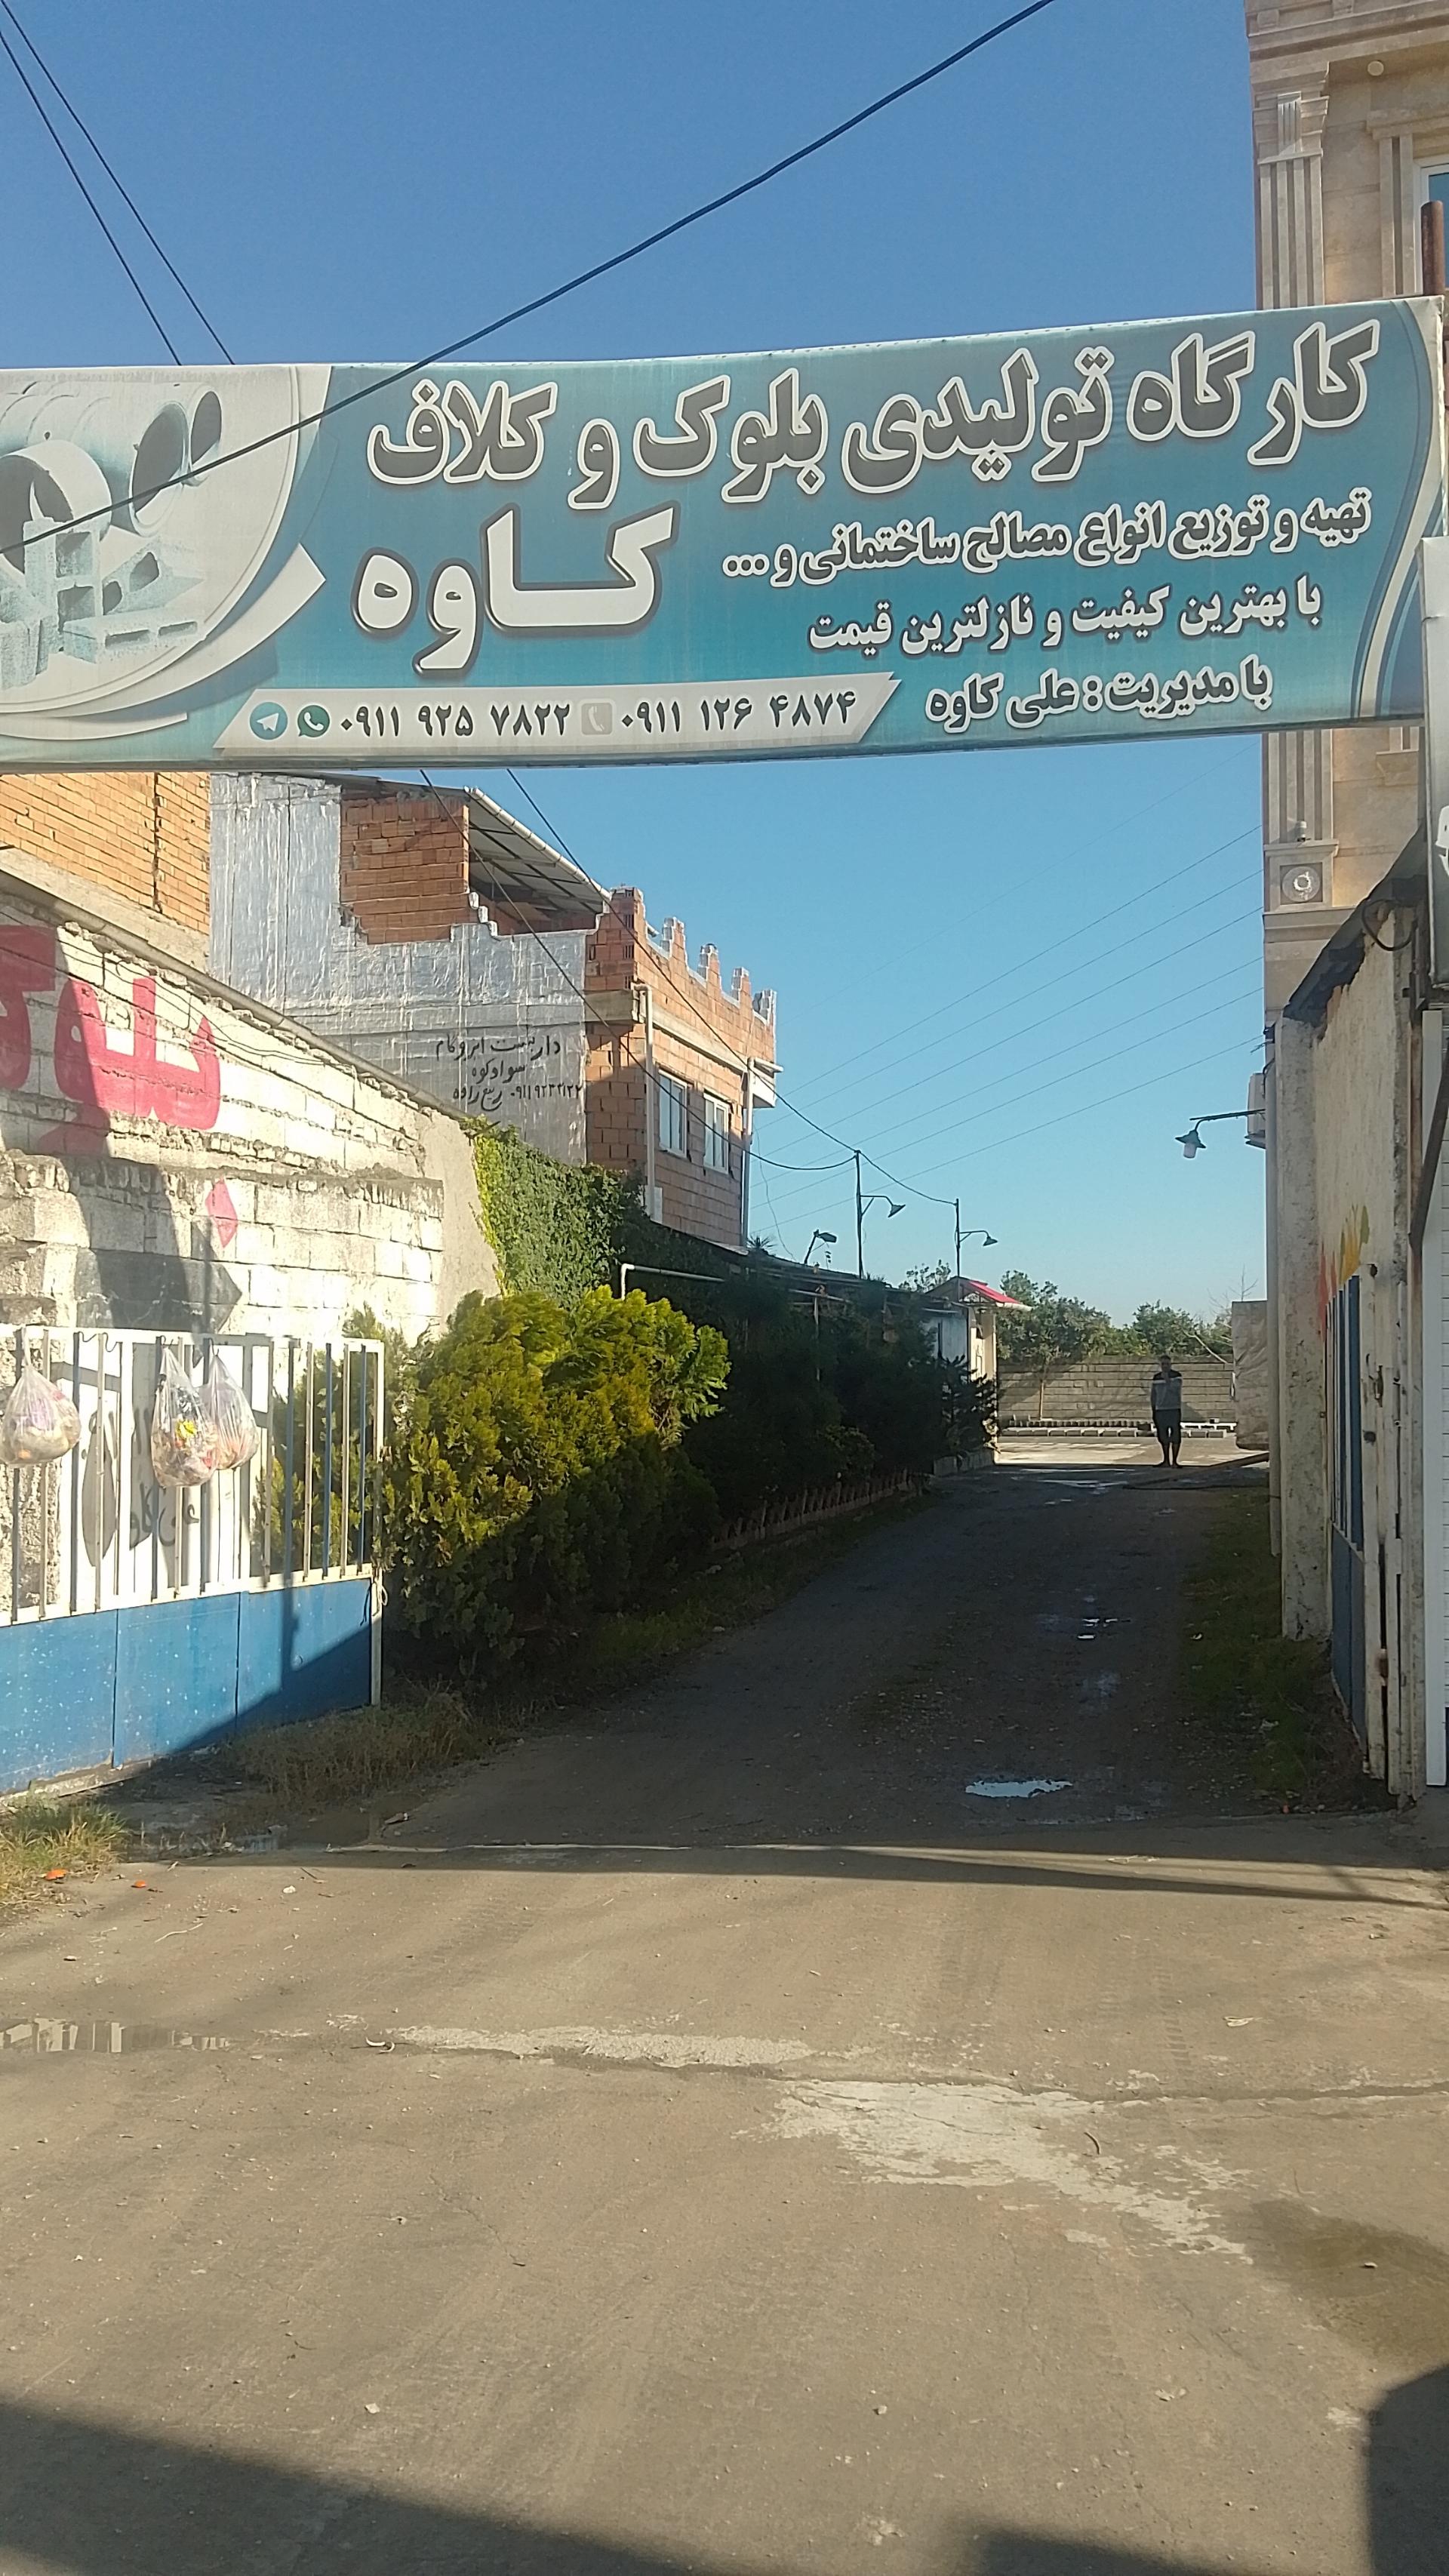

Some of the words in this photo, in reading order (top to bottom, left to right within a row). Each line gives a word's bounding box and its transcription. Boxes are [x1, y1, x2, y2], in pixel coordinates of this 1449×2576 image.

[841, 346, 1115, 494] تولیدی
[1126, 319, 1380, 466] کارگاه
[367, 379, 558, 485] کلاف
[633, 368, 829, 504] بلوک
[568, 417, 620, 509] و
[962, 510, 1072, 573] مصالح
[1074, 500, 1167, 567] انواع
[1168, 494, 1270, 561] توزیع
[1270, 508, 1297, 553] و
[1300, 487, 1372, 547] تهیه
[798, 516, 960, 586] ساختمانی
[355, 506, 675, 674] کاوه
[1071, 585, 1171, 641] کیفیت
[1179, 584, 1287, 635] بهترین
[1296, 575, 1322, 626] با
[809, 601, 893, 656] قیمت
[901, 593, 1034, 654] نازلترین
[1042, 607, 1062, 647] و
[621, 700, 681, 734] ۰۹۱۱
[700, 697, 752, 731] ۱۲۶
[768, 689, 857, 728] ۴۸۷۴
[925, 672, 1004, 734] کاوه
[1005, 668, 1080, 728] علی
[1239, 654, 1273, 711] با
[340, 705, 400, 737] ۰۹۱۱
[417, 704, 474, 737] ۹۲۵
[490, 703, 571, 736] ۷۸۲۲
